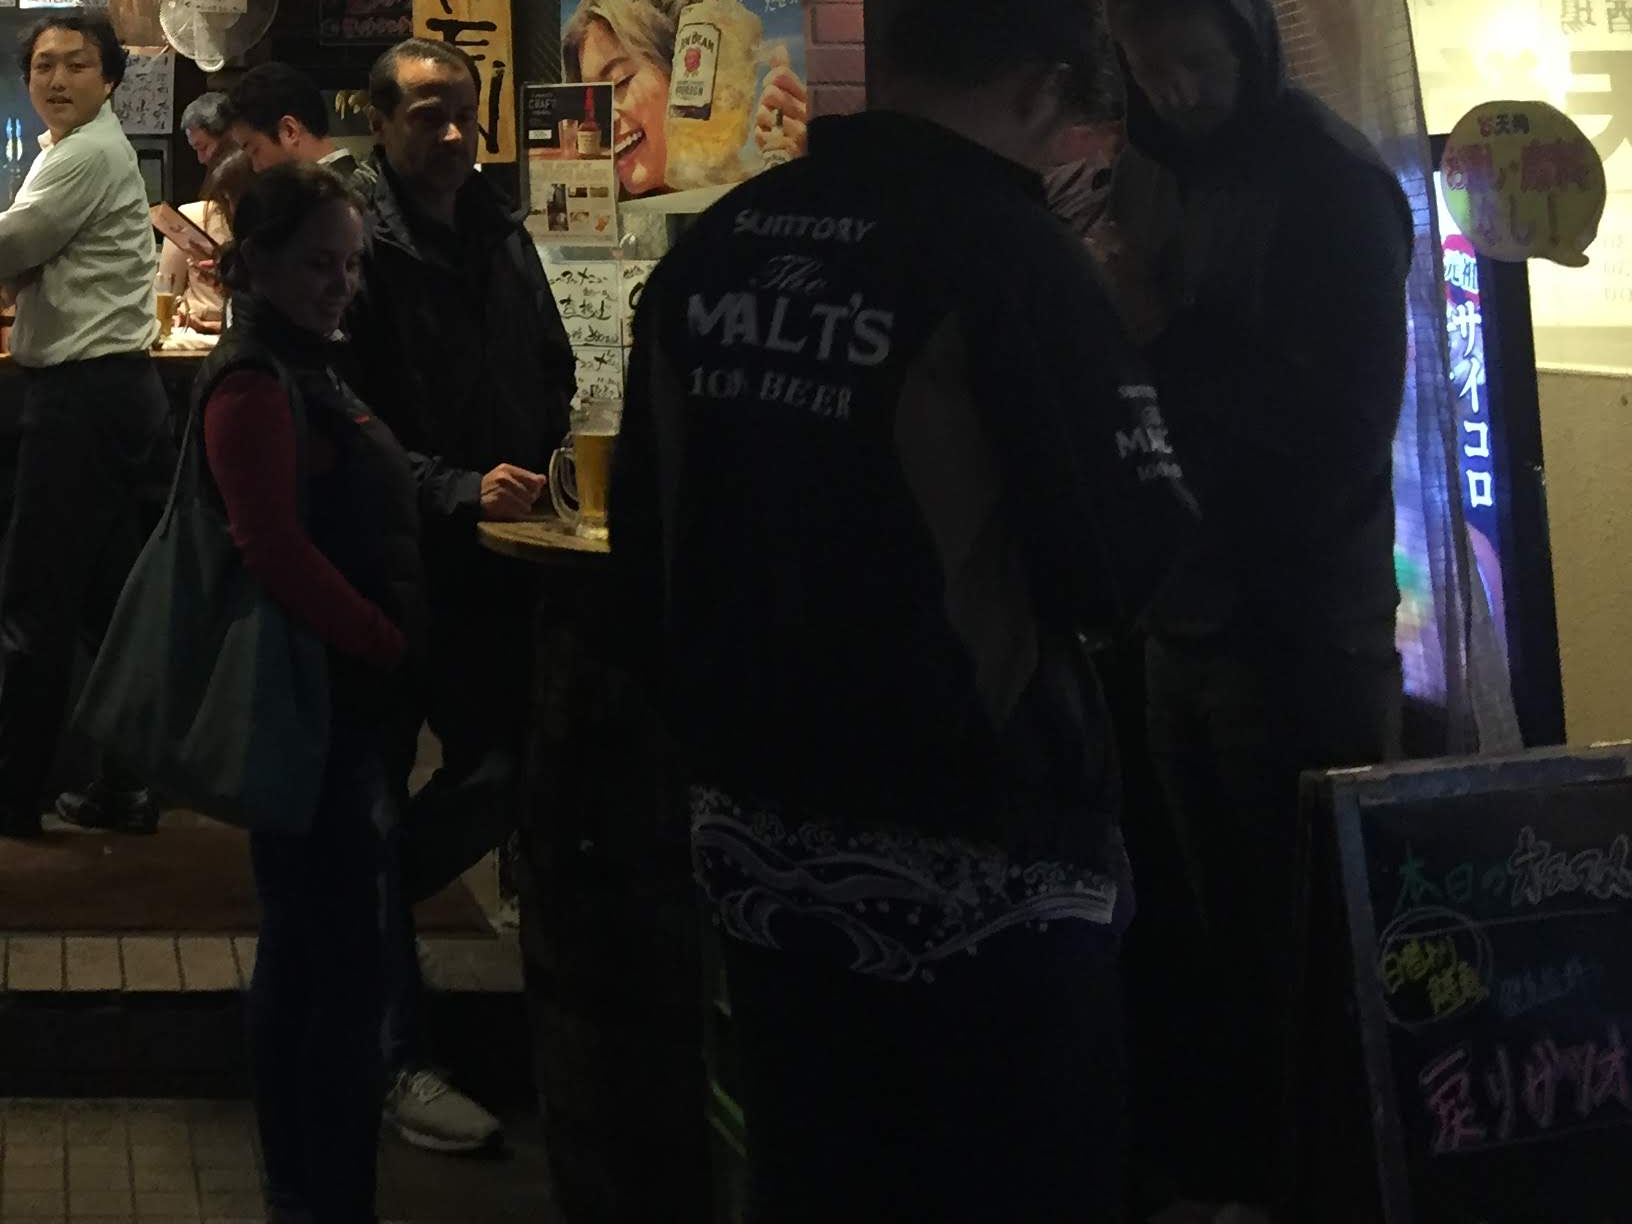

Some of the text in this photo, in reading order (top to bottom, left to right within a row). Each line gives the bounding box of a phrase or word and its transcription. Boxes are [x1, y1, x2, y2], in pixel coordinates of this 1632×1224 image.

[692, 30, 715, 53] BEAM
[687, 289, 896, 368] MALT'S
[1447, 300, 1493, 508] サイコロ
